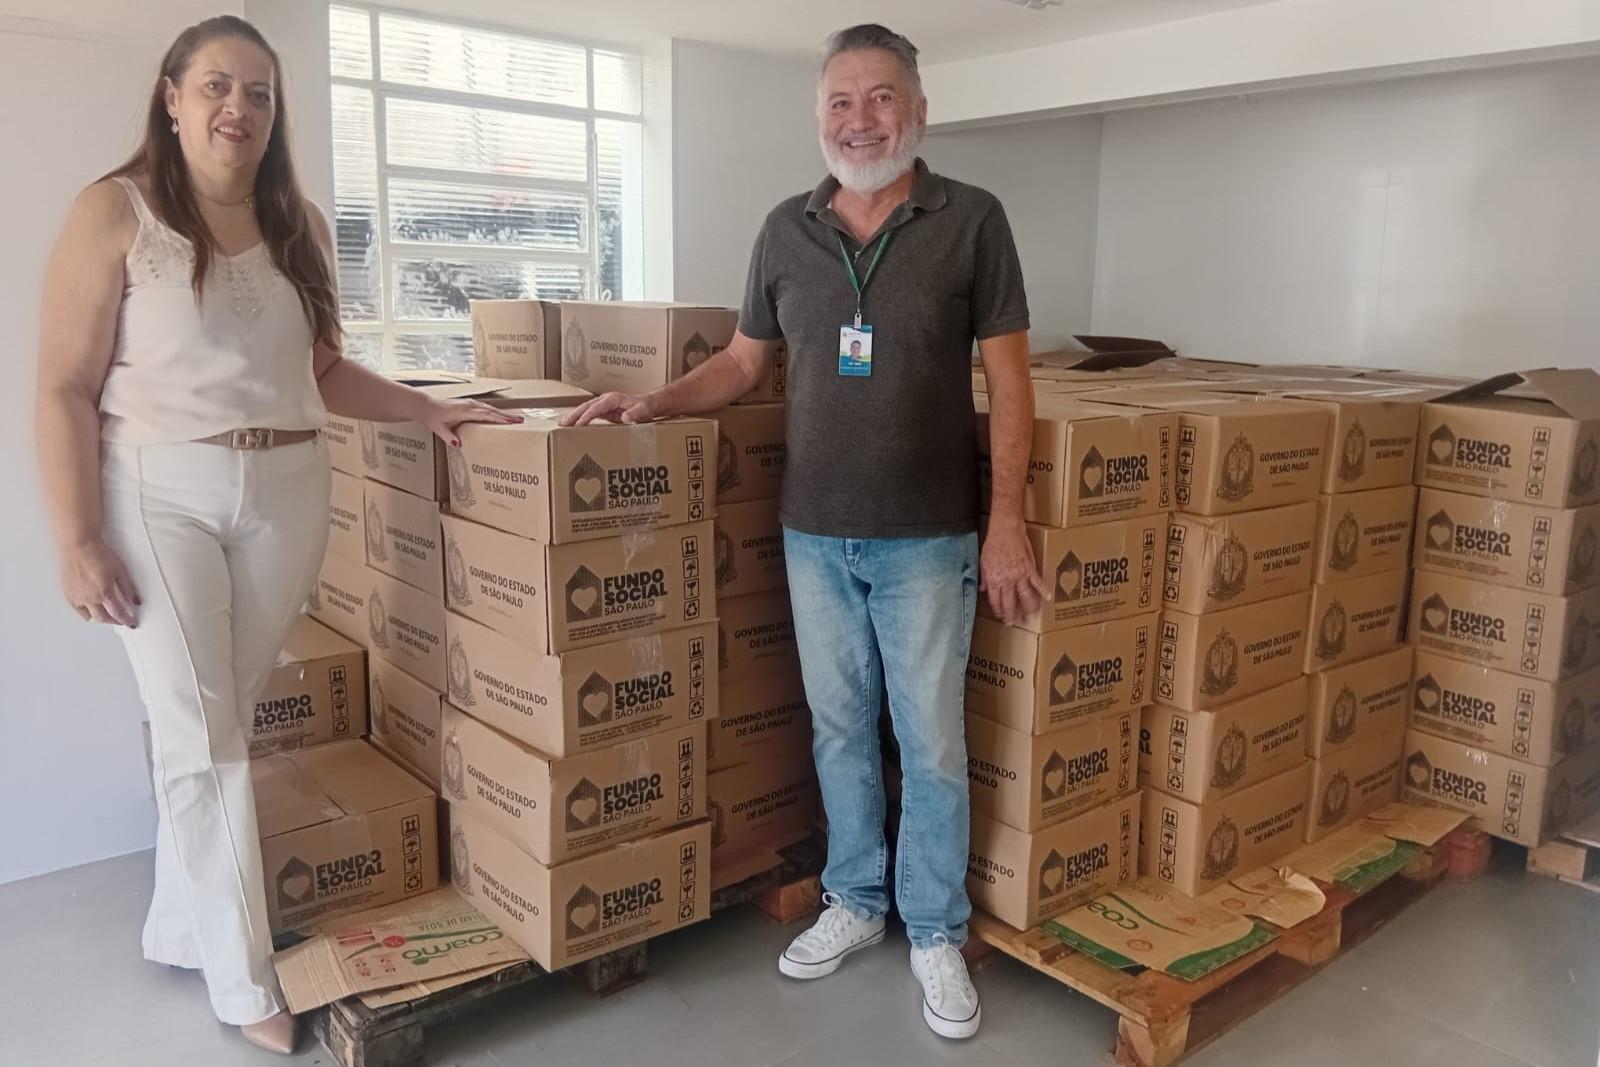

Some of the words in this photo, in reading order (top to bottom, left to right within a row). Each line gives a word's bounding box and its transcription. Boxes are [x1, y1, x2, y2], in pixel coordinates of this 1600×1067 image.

[591, 341, 618, 352] GOVERNO
[620, 344, 628, 353] DO
[630, 344, 656, 356] ESTADO
[600, 356, 608, 364] DE
[610, 355, 622, 366] SÃO
[623, 358, 643, 368] PAULO
[1260, 451, 1288, 462] GOVERNO
[1290, 450, 1299, 459] DO
[1300, 448, 1320, 457] ESTADO
[1458, 438, 1511, 454] FUNDO
[1107, 455, 1147, 472] FUNDO
[1270, 465, 1278, 474] DE
[1279, 462, 1290, 473] SÃO
[1292, 462, 1308, 471] PAULO
[1455, 462, 1471, 470] SÃO
[1473, 463, 1499, 474] PAULO
[1456, 450, 1512, 468] SOCIAL
[472, 464, 499, 480] GOVERNO
[500, 471, 509, 482] DO
[511, 472, 539, 486] ESTADO
[608, 465, 668, 484] FUNDO
[1106, 469, 1149, 486] SOCIAL
[484, 482, 491, 491] DE
[492, 482, 503, 494] SÃO
[505, 486, 526, 500] PAULO
[608, 480, 672, 499] SOCIAL
[608, 498, 628, 508] SÃO
[630, 496, 659, 507] PAULO
[1456, 524, 1511, 544] FUNDO
[1253, 549, 1282, 560] GOVERNO
[1283, 546, 1291, 556] DO
[1292, 541, 1311, 554] ESTADO
[1455, 537, 1512, 556] SOCIAL
[1455, 548, 1471, 556] SÃO
[1472, 549, 1499, 561] PAULO
[1085, 557, 1128, 576] FUNDO
[1263, 563, 1271, 572] DE
[1272, 560, 1283, 570] SÃO
[1284, 557, 1302, 568] PAULO
[469, 566, 497, 585] GOVERNO
[498, 577, 508, 589] DO
[509, 579, 536, 596] ESTADO
[604, 569, 664, 589] FUNDO
[1084, 570, 1129, 589] SOCIAL
[480, 584, 488, 595] DE
[490, 585, 501, 600] SÃO
[502, 591, 523, 608] PAULO
[604, 584, 667, 606] SOCIAL
[1082, 589, 1096, 598] SÃO
[1098, 585, 1119, 595] PAULO
[605, 605, 624, 615] SÃO
[626, 599, 655, 612] PAULO
[1451, 609, 1504, 629] FUNDO
[1243, 639, 1272, 654] GOVERNO
[1274, 638, 1283, 647] DO
[1283, 630, 1301, 645] ESTADO
[1450, 621, 1506, 642] SOCIAL
[1450, 631, 1464, 640] SÃO
[1467, 633, 1493, 646] PAULO
[1253, 655, 1261, 665] DE
[1262, 652, 1274, 662] SÃO
[1275, 646, 1292, 660] PAULO
[974, 657, 987, 668] DO
[989, 659, 1023, 679] ESTADO
[1079, 657, 1122, 676] FUNDO
[474, 669, 503, 690] GOVERNO
[505, 683, 515, 695] DO
[516, 686, 548, 706] ESTADO
[615, 671, 672, 696] FUNDO
[977, 672, 1005, 688] PAULO
[1078, 670, 1123, 691] SOCIAL
[486, 688, 493, 700] DE
[495, 690, 508, 706] SÃO
[510, 698, 533, 717] PAULO
[615, 686, 674, 710] SOCIAL
[1077, 690, 1091, 700] SÃO
[1093, 685, 1113, 696] PAULO
[1443, 690, 1495, 712] FUNDO
[255, 694, 311, 716] FUNDO
[615, 709, 633, 719] SÃO
[635, 701, 663, 715] PAULO
[1442, 702, 1497, 725] SOCIAL
[253, 724, 272, 735] SÃO
[274, 720, 304, 732] PAULO
[254, 709, 315, 727] SOCIAL
[720, 712, 762, 728] GOVERNO
[763, 710, 776, 719] DO
[736, 726, 747, 737] DE
[767, 716, 793, 731] PAULO
[1441, 712, 1457, 722] SÃO
[1459, 715, 1484, 729] PAULO
[1252, 728, 1279, 745] GOVERNO
[1280, 724, 1288, 733] DO
[1289, 714, 1304, 729] ESTADO
[1262, 743, 1270, 753] DE
[1283, 731, 1298, 745] PAULO
[979, 761, 1016, 780] ESTADO
[1068, 748, 1108, 772] FUNDO
[969, 772, 997, 788] PAULO
[1068, 760, 1109, 785] SOCIAL
[1433, 768, 1486, 792] FUNDO
[467, 765, 494, 789] GOVERNO
[495, 782, 505, 795] DO
[506, 786, 536, 809] ESTADO
[604, 774, 661, 801] FUNDO
[1432, 779, 1488, 805] SOCIAL
[477, 785, 484, 796] DE
[486, 788, 498, 805] SÃO
[500, 799, 521, 818] PAULO
[603, 790, 664, 815] SOCIAL
[1432, 790, 1448, 800] SÃO
[1449, 793, 1475, 807] PAULO
[603, 813, 621, 824] SÃO
[624, 804, 651, 818] PAULO
[1244, 818, 1273, 836] GOVERNO
[1274, 814, 1282, 823] DO
[1283, 803, 1303, 820] ESTADO
[1254, 834, 1262, 844] DE
[1276, 821, 1293, 835] PAULO
[316, 850, 382, 876] FUNDO
[978, 856, 1014, 878] ESTADO
[1067, 844, 1108, 870] FUNDO
[318, 864, 385, 890] SOCIAL
[969, 867, 996, 884] PAULO
[1066, 856, 1110, 881] SOCIAL
[318, 887, 339, 899] SÃO
[341, 878, 372, 894] PAULO
[473, 863, 499, 890] GOVERNO
[500, 884, 509, 898] DO
[510, 888, 539, 916] ESTADO
[603, 878, 661, 907] FUNDO
[482, 885, 489, 897] DE
[490, 887, 502, 907] SÃO
[503, 901, 524, 923] PAULO
[602, 894, 663, 920] SOCIAL
[602, 918, 621, 929] SÃO
[623, 908, 651, 925] PAULO
[1087, 902, 1139, 930] coa
[402, 931, 503, 960] coamo
